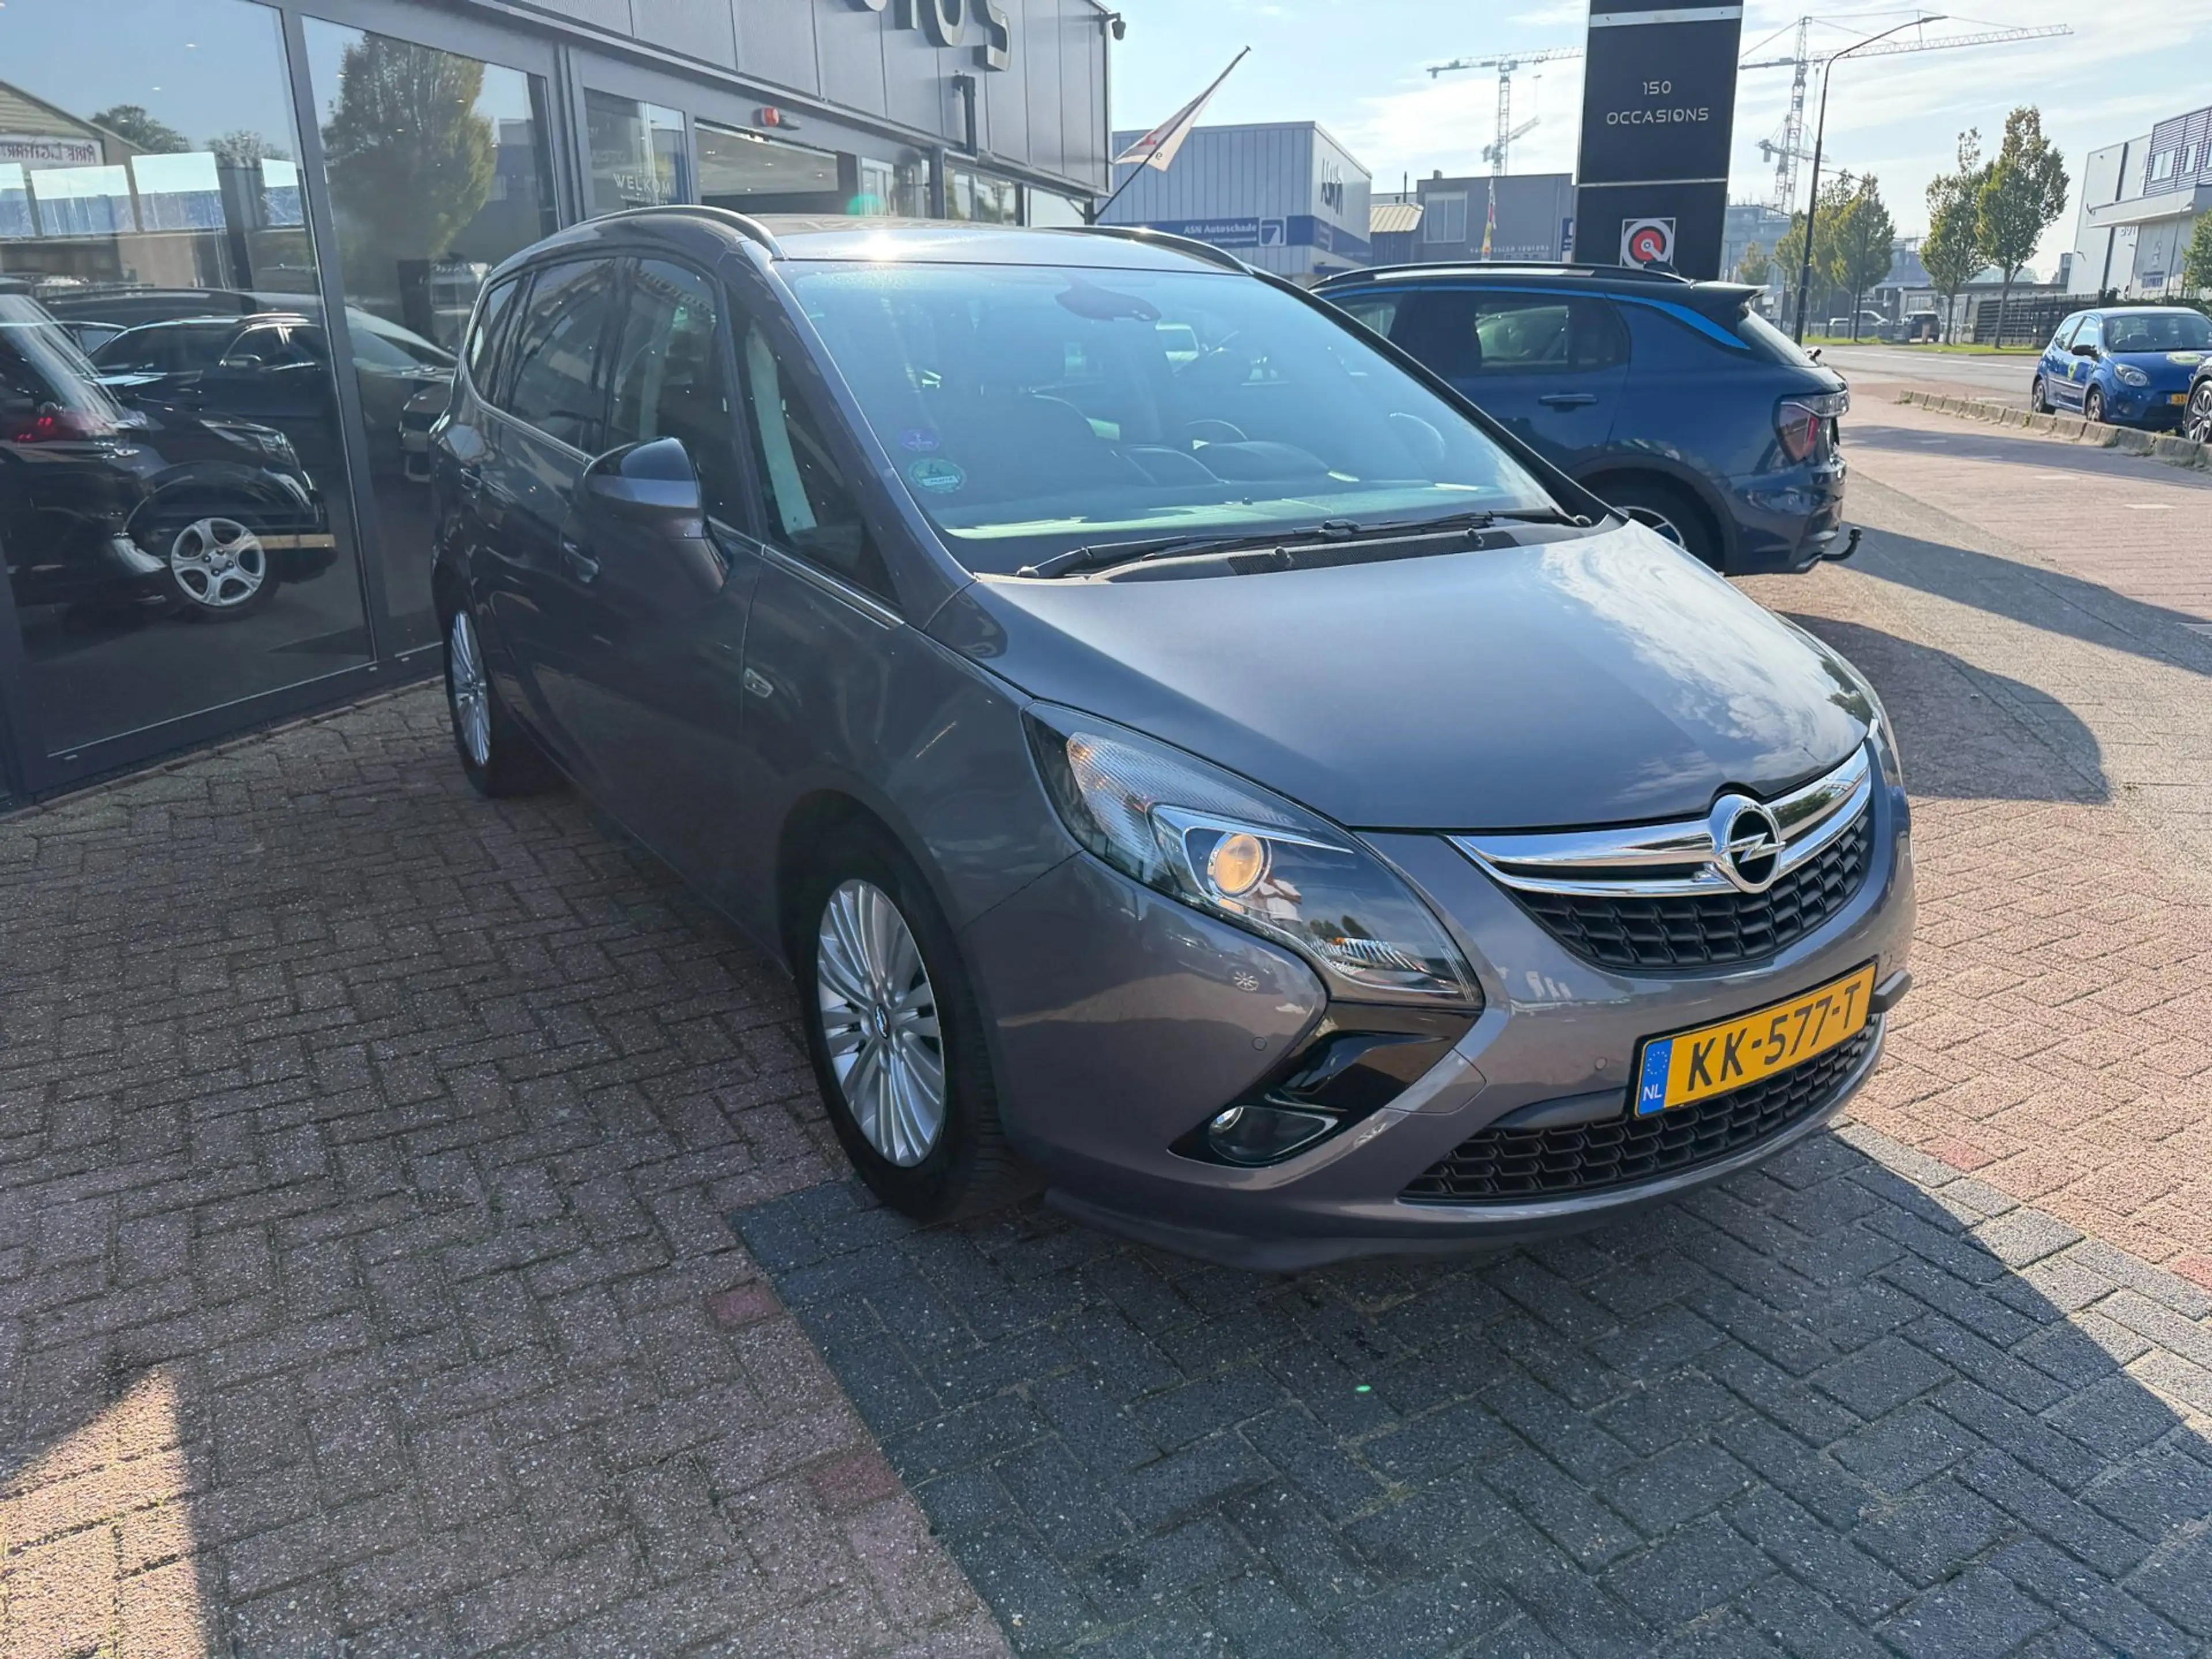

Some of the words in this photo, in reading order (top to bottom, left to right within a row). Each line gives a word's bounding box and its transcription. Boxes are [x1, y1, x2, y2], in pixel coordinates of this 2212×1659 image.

[1642, 81, 1672, 95] 150
[1606, 107, 1709, 125] OCCASIONS
[613, 173, 672, 195] WELKOM
[1183, 225, 1202, 234] ASN
[1204, 223, 1257, 233] Autoschade
[1687, 980, 1861, 1092] KK-577-T
[1642, 1084, 1662, 1101] NL
